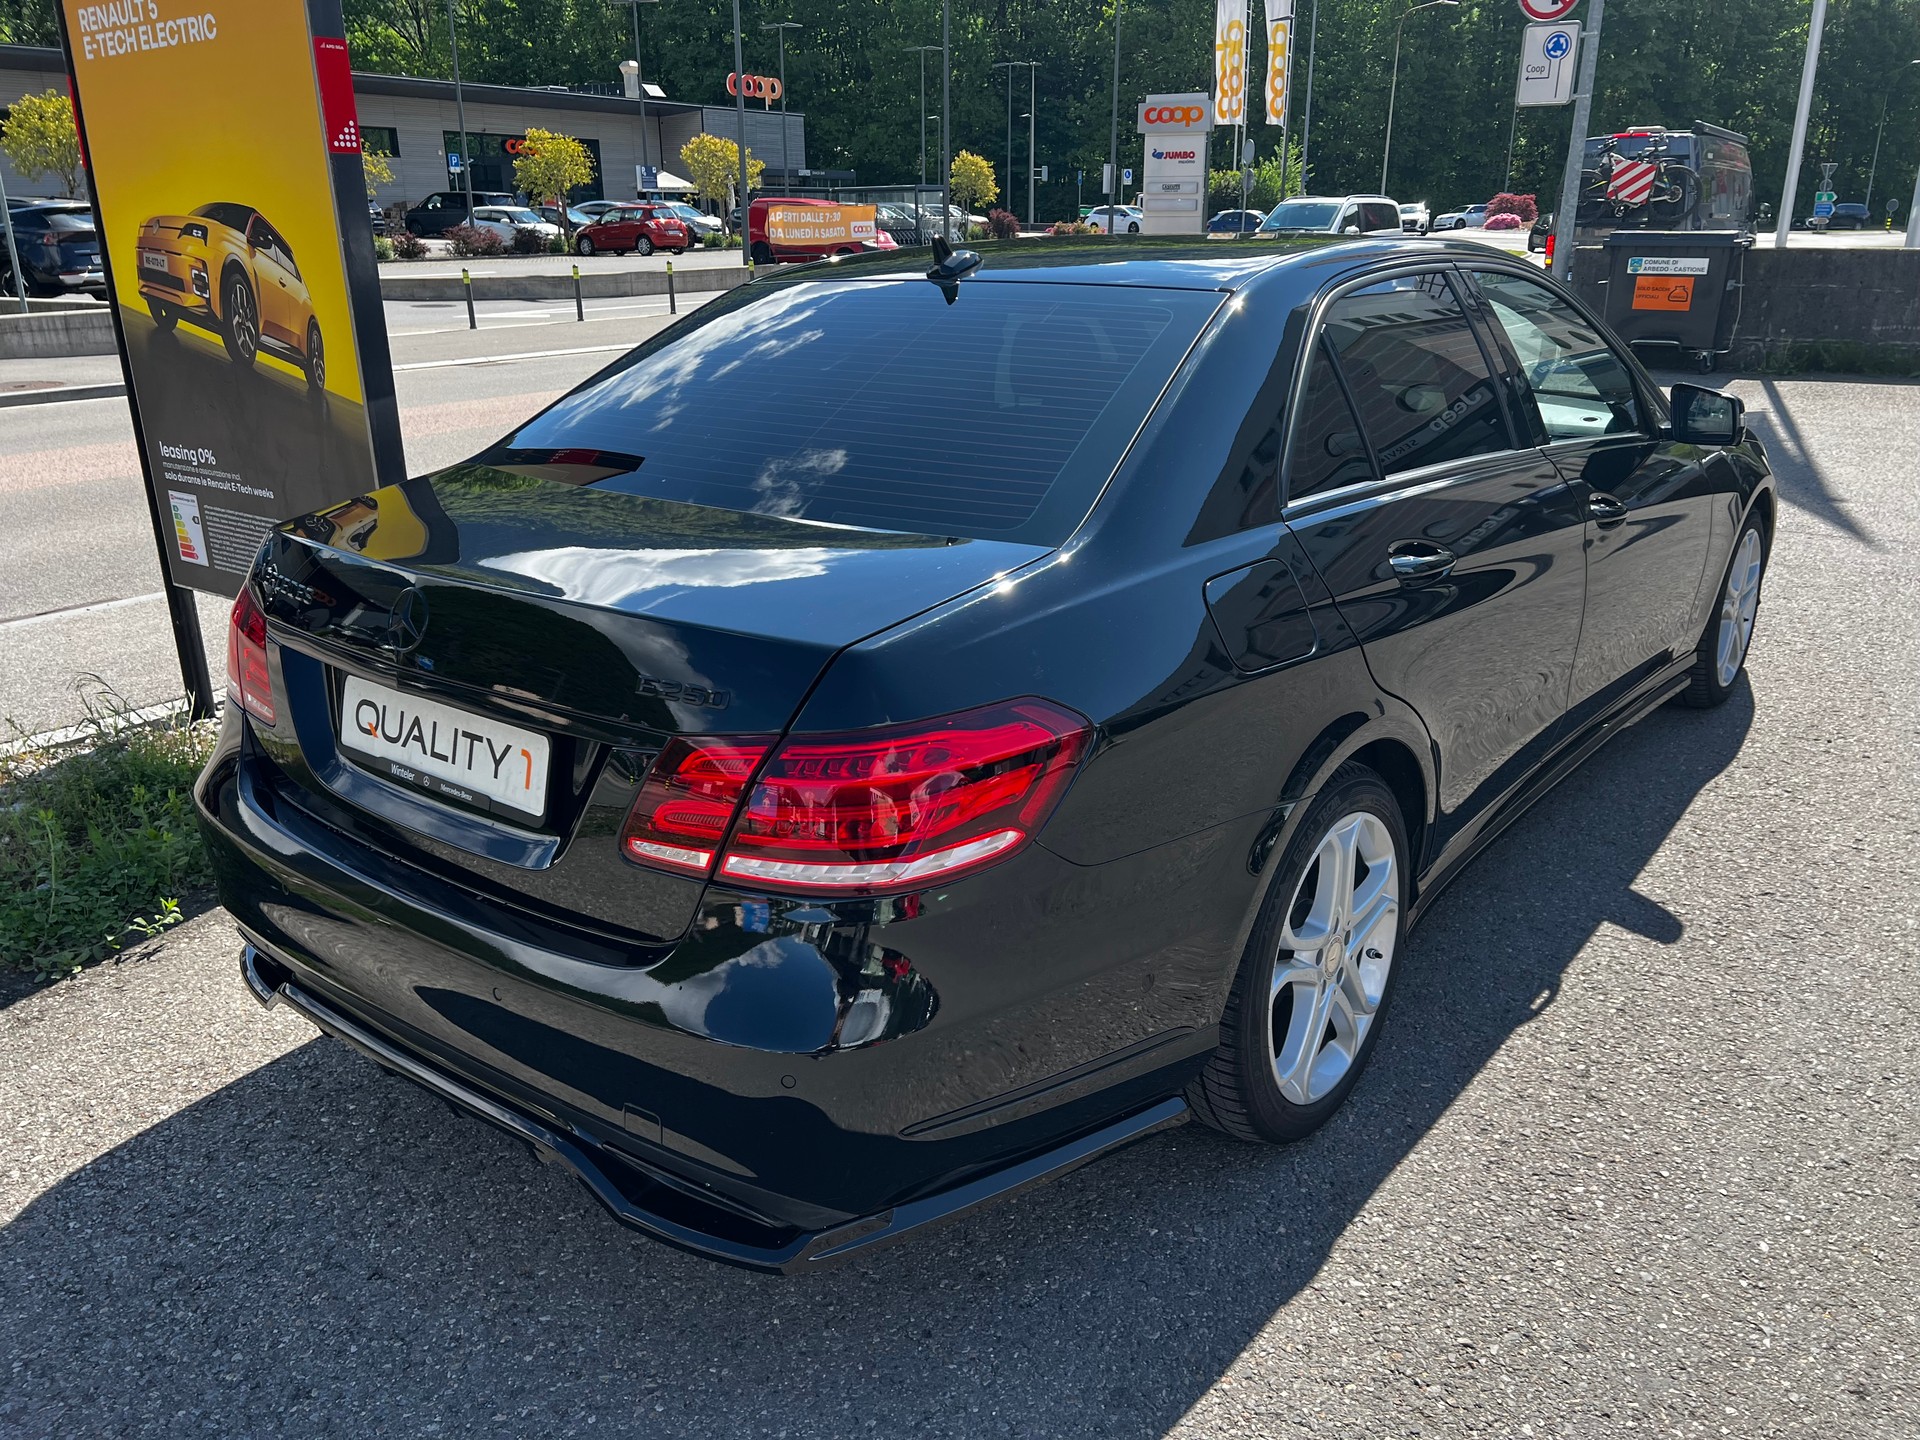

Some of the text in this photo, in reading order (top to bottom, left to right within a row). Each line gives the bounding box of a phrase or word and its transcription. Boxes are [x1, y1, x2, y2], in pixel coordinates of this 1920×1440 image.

[78, 0, 158, 32] RENAULT 5
[83, 13, 217, 59] E-TECH ELECTRIC
[1526, 64, 1546, 75] Coop
[726, 72, 783, 105] coop
[1144, 106, 1204, 127] coop
[1164, 151, 1195, 159] JUMBO
[769, 211, 841, 222] APERTI DALLE 7:30
[769, 226, 845, 239] DA LUNEDÌ A SABATO
[853, 225, 872, 234] coop
[159, 440, 216, 466] leasing 0%
[164, 471, 274, 499] solo durante le Renault E-Tech weeks
[355, 699, 512, 779] QUALITY
[391, 763, 415, 781] Winteler
[440, 783, 473, 801] Mercedes-Benz
